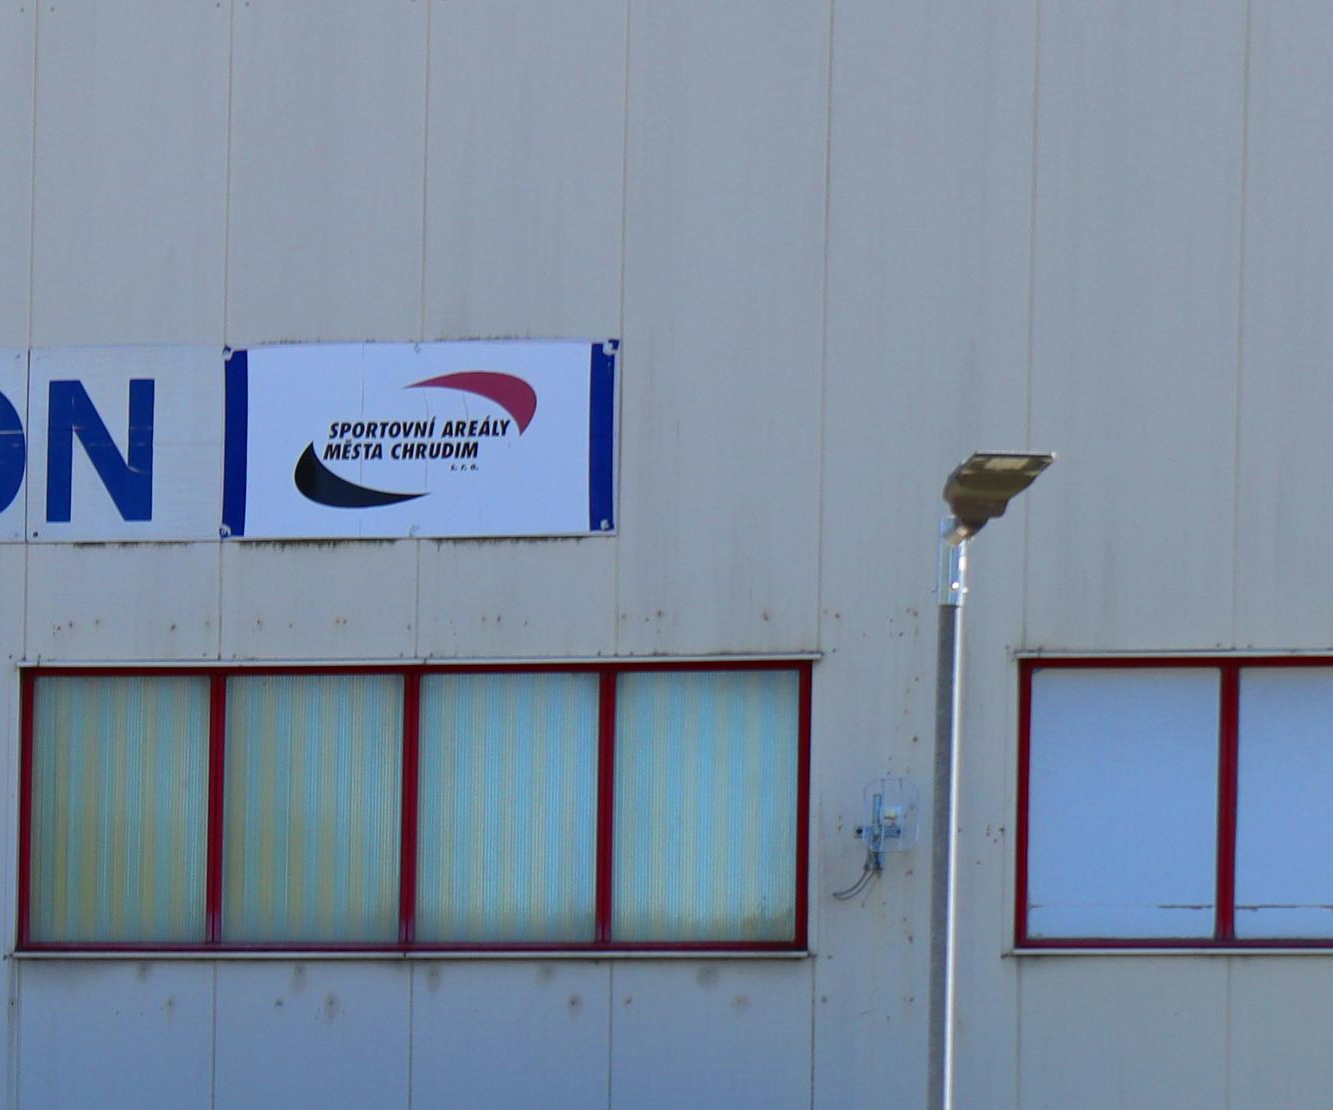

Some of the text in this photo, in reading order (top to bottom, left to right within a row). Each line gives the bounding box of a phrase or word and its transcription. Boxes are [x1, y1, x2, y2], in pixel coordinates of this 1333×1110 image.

[328, 415, 511, 439] SPORTOVNÍ AREÁLY
[323, 440, 479, 460] MĚSTA CHRUDIM
